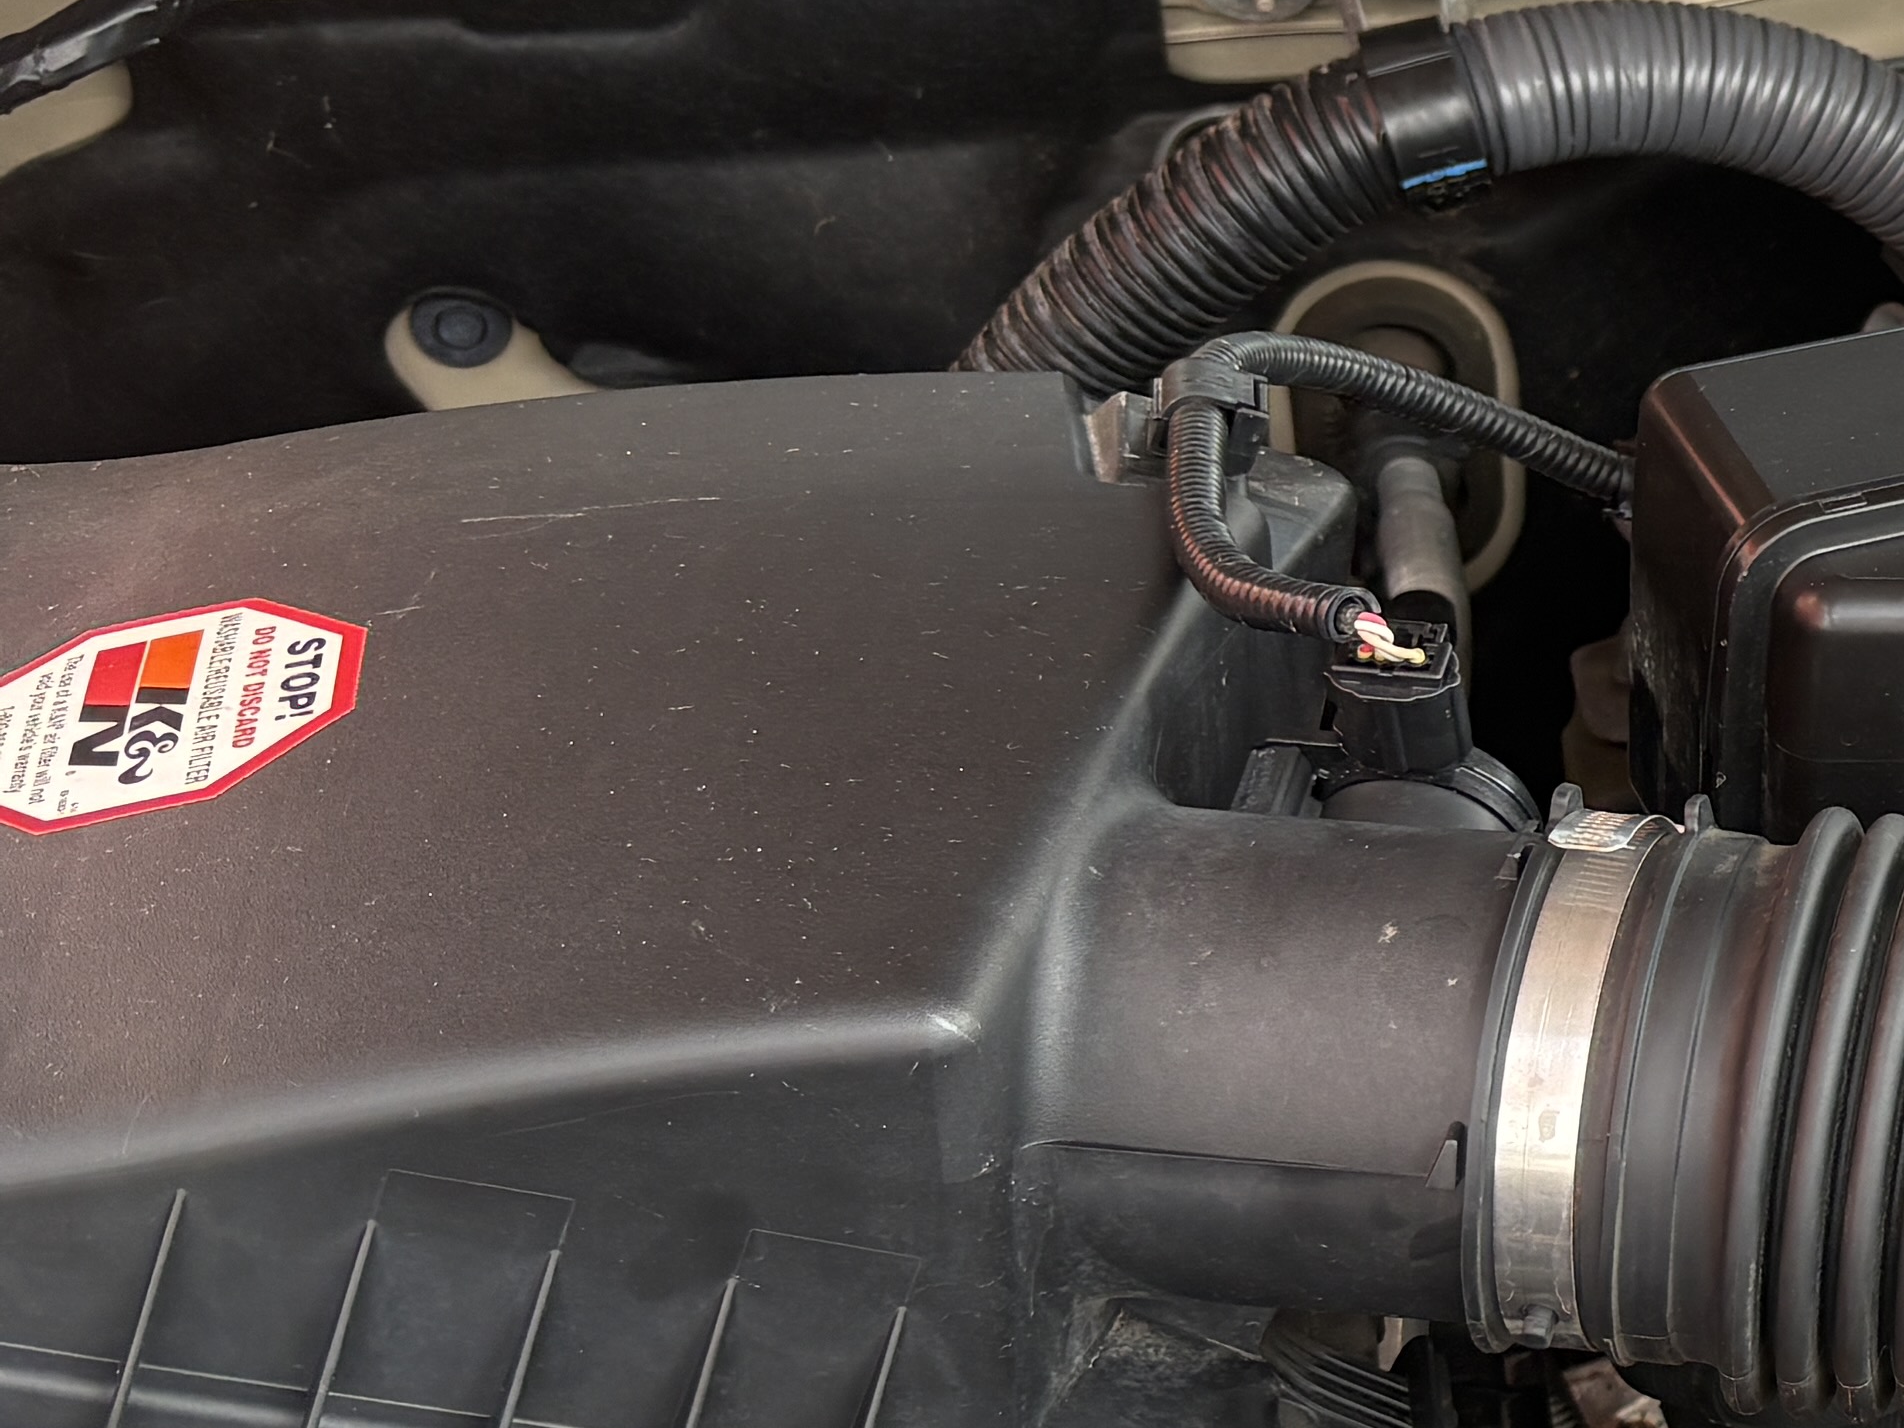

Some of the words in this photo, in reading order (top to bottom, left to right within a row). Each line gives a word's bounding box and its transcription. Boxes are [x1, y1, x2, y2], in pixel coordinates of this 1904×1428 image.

[252, 626, 277, 645] DO
[245, 648, 272, 677] NOT
[274, 637, 327, 721] STOP!
[232, 682, 265, 749] DISCARD
[192, 724, 218, 745] AIR
[184, 745, 214, 785] FILTER
[28, 788, 45, 804] not
